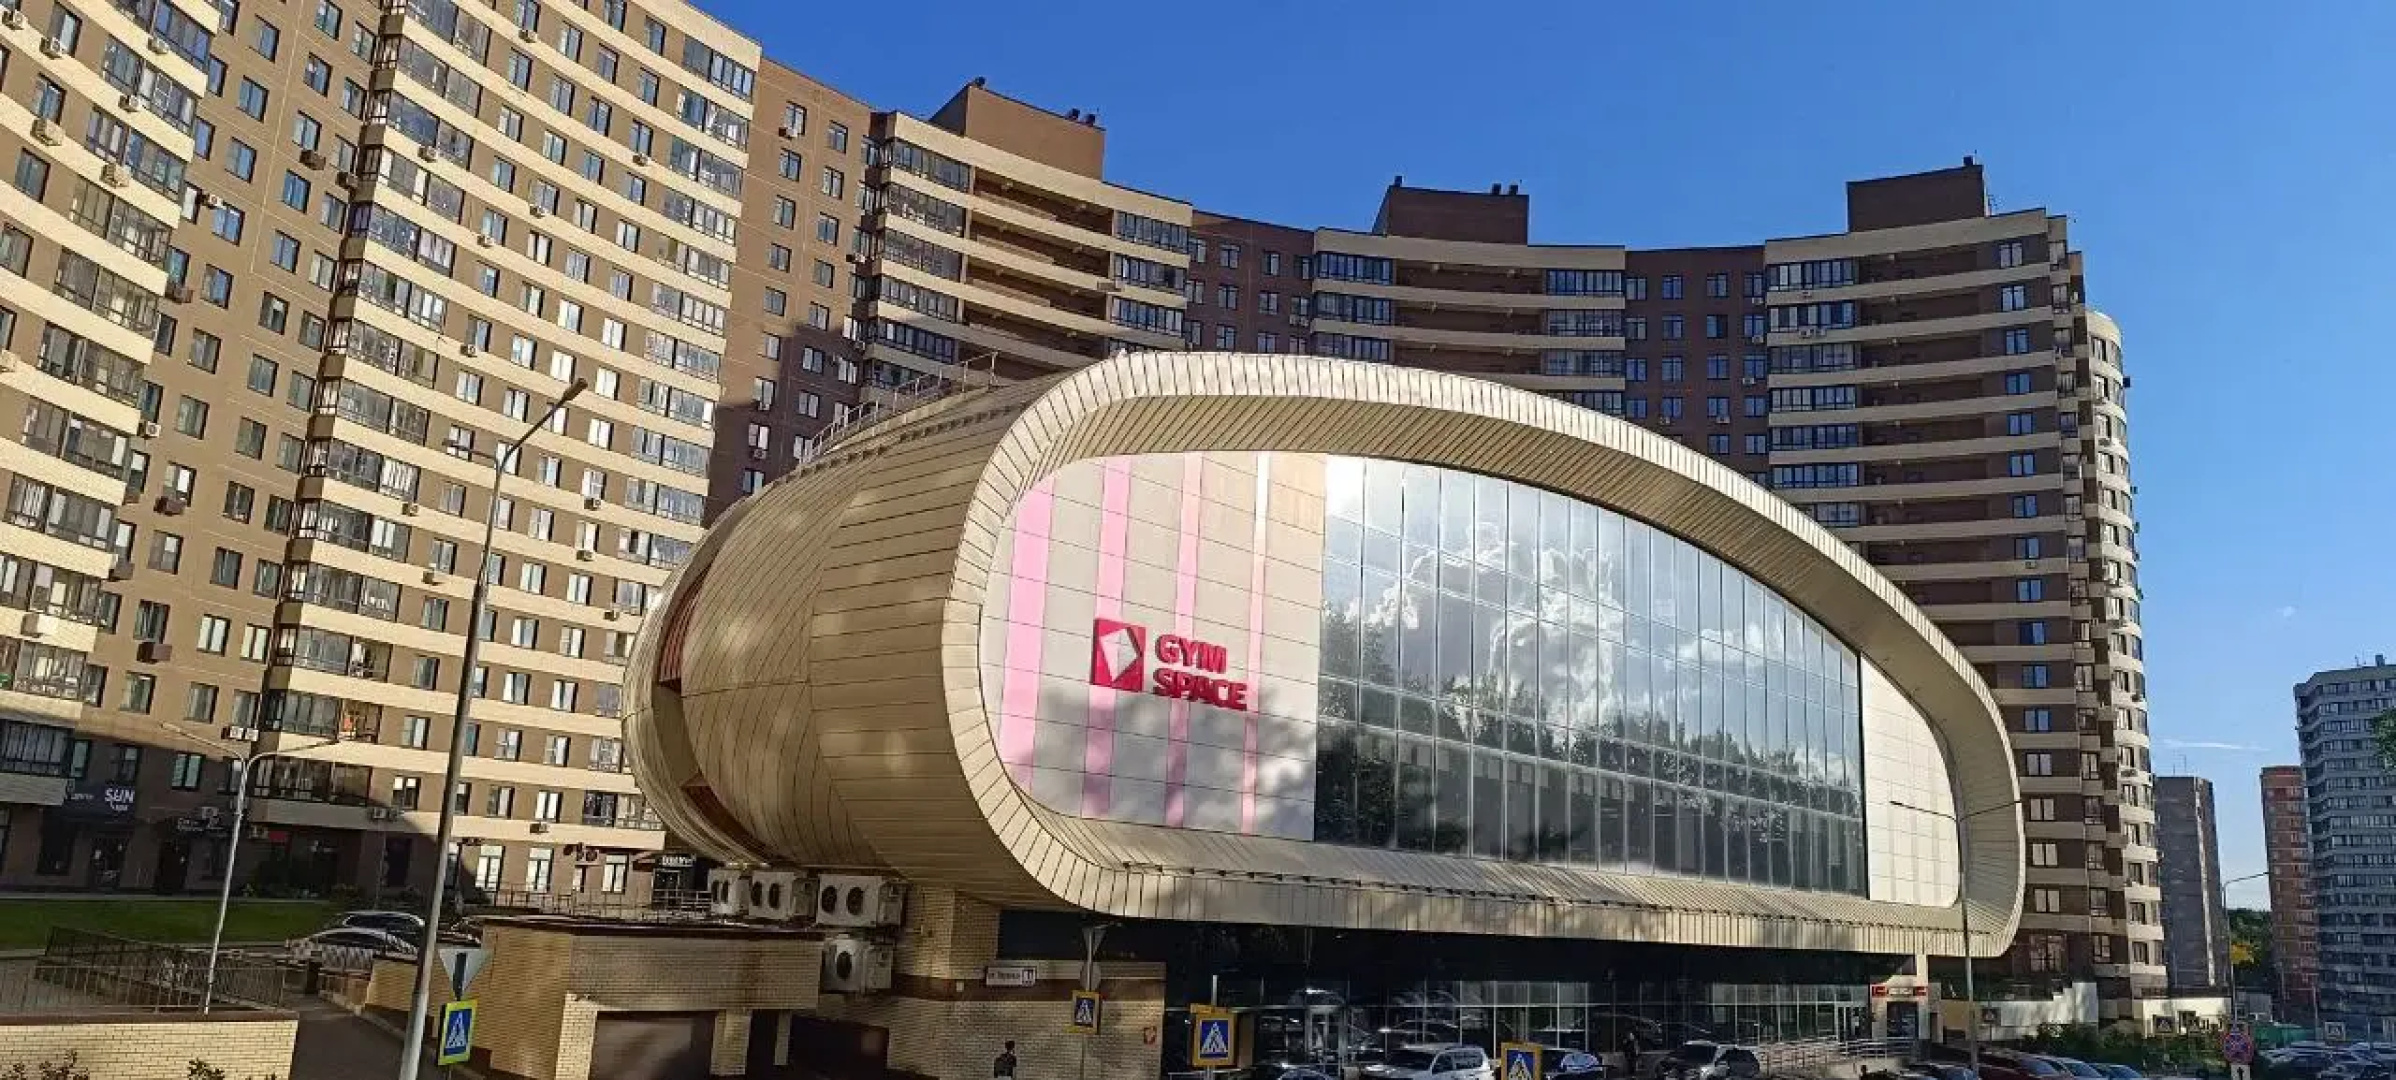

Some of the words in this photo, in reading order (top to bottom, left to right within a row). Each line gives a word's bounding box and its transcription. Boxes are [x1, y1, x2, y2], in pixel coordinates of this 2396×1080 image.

[1155, 634, 1227, 674] GYM
[1153, 668, 1248, 711] SPACE
[105, 788, 135, 803] SUN
